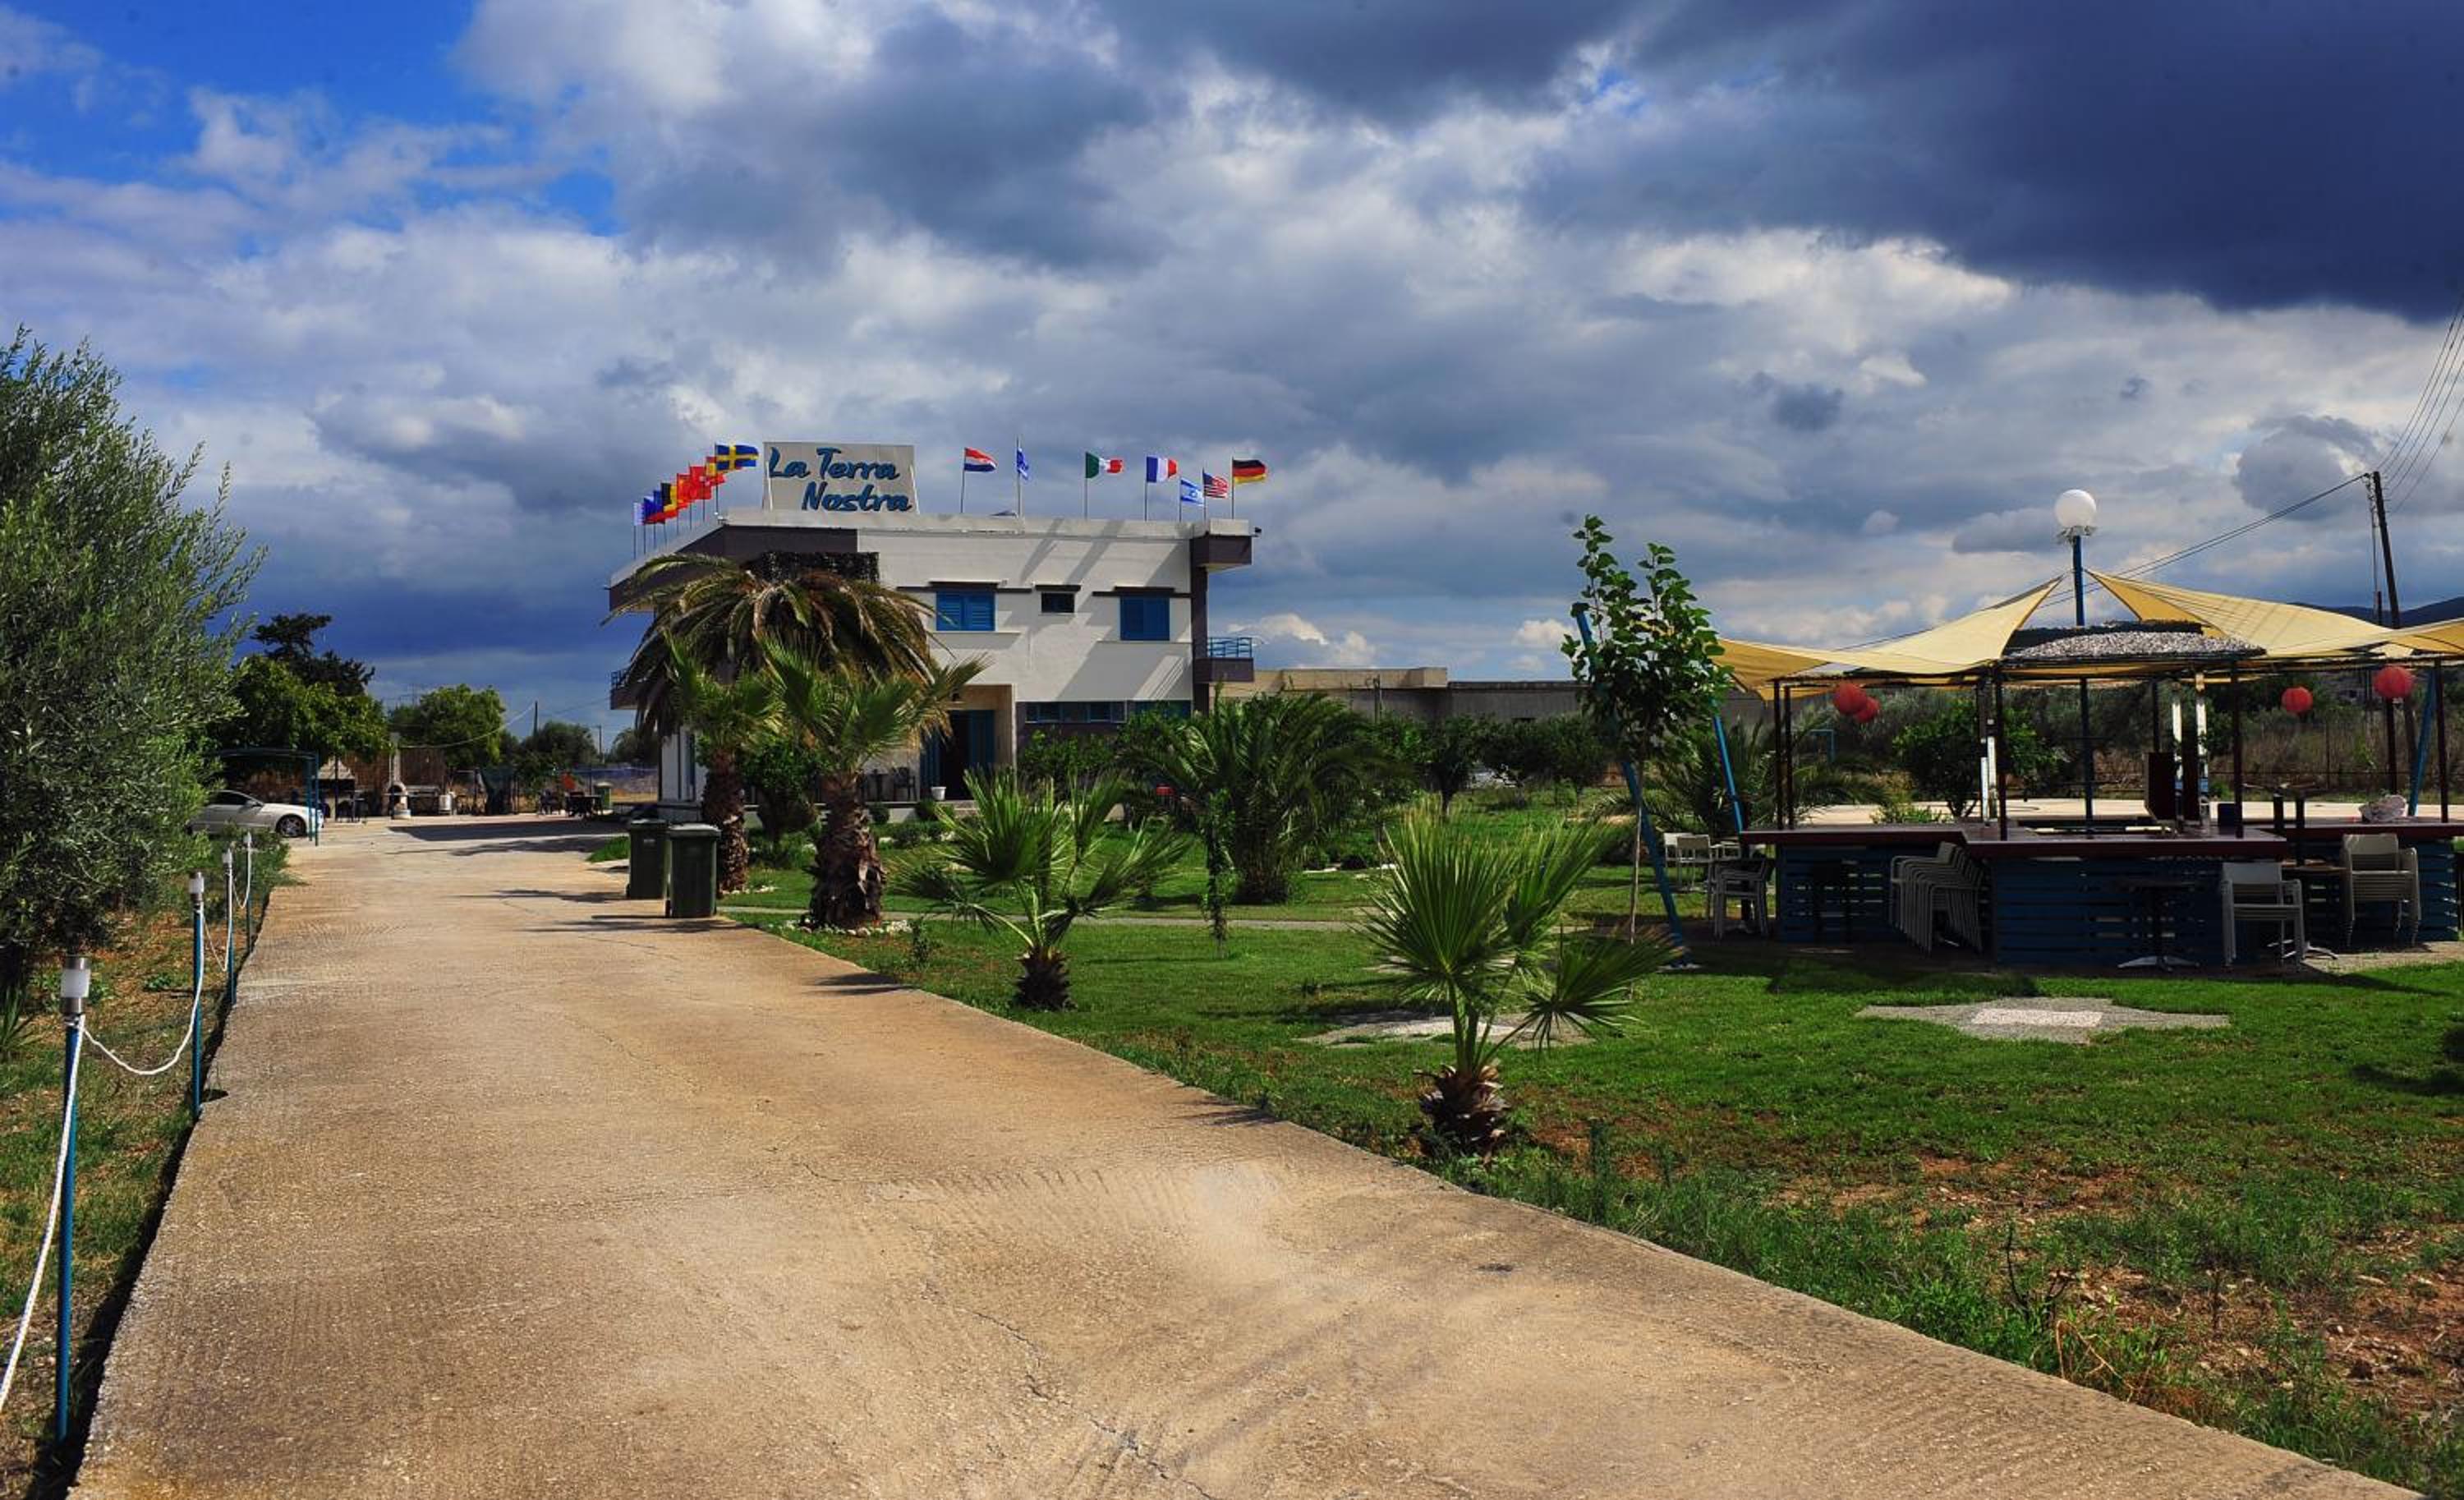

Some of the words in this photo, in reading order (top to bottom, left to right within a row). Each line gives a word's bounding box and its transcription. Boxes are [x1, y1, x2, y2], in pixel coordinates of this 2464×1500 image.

[770, 447, 811, 478] La
[816, 447, 901, 480] Terra
[802, 481, 913, 512] Nostra
